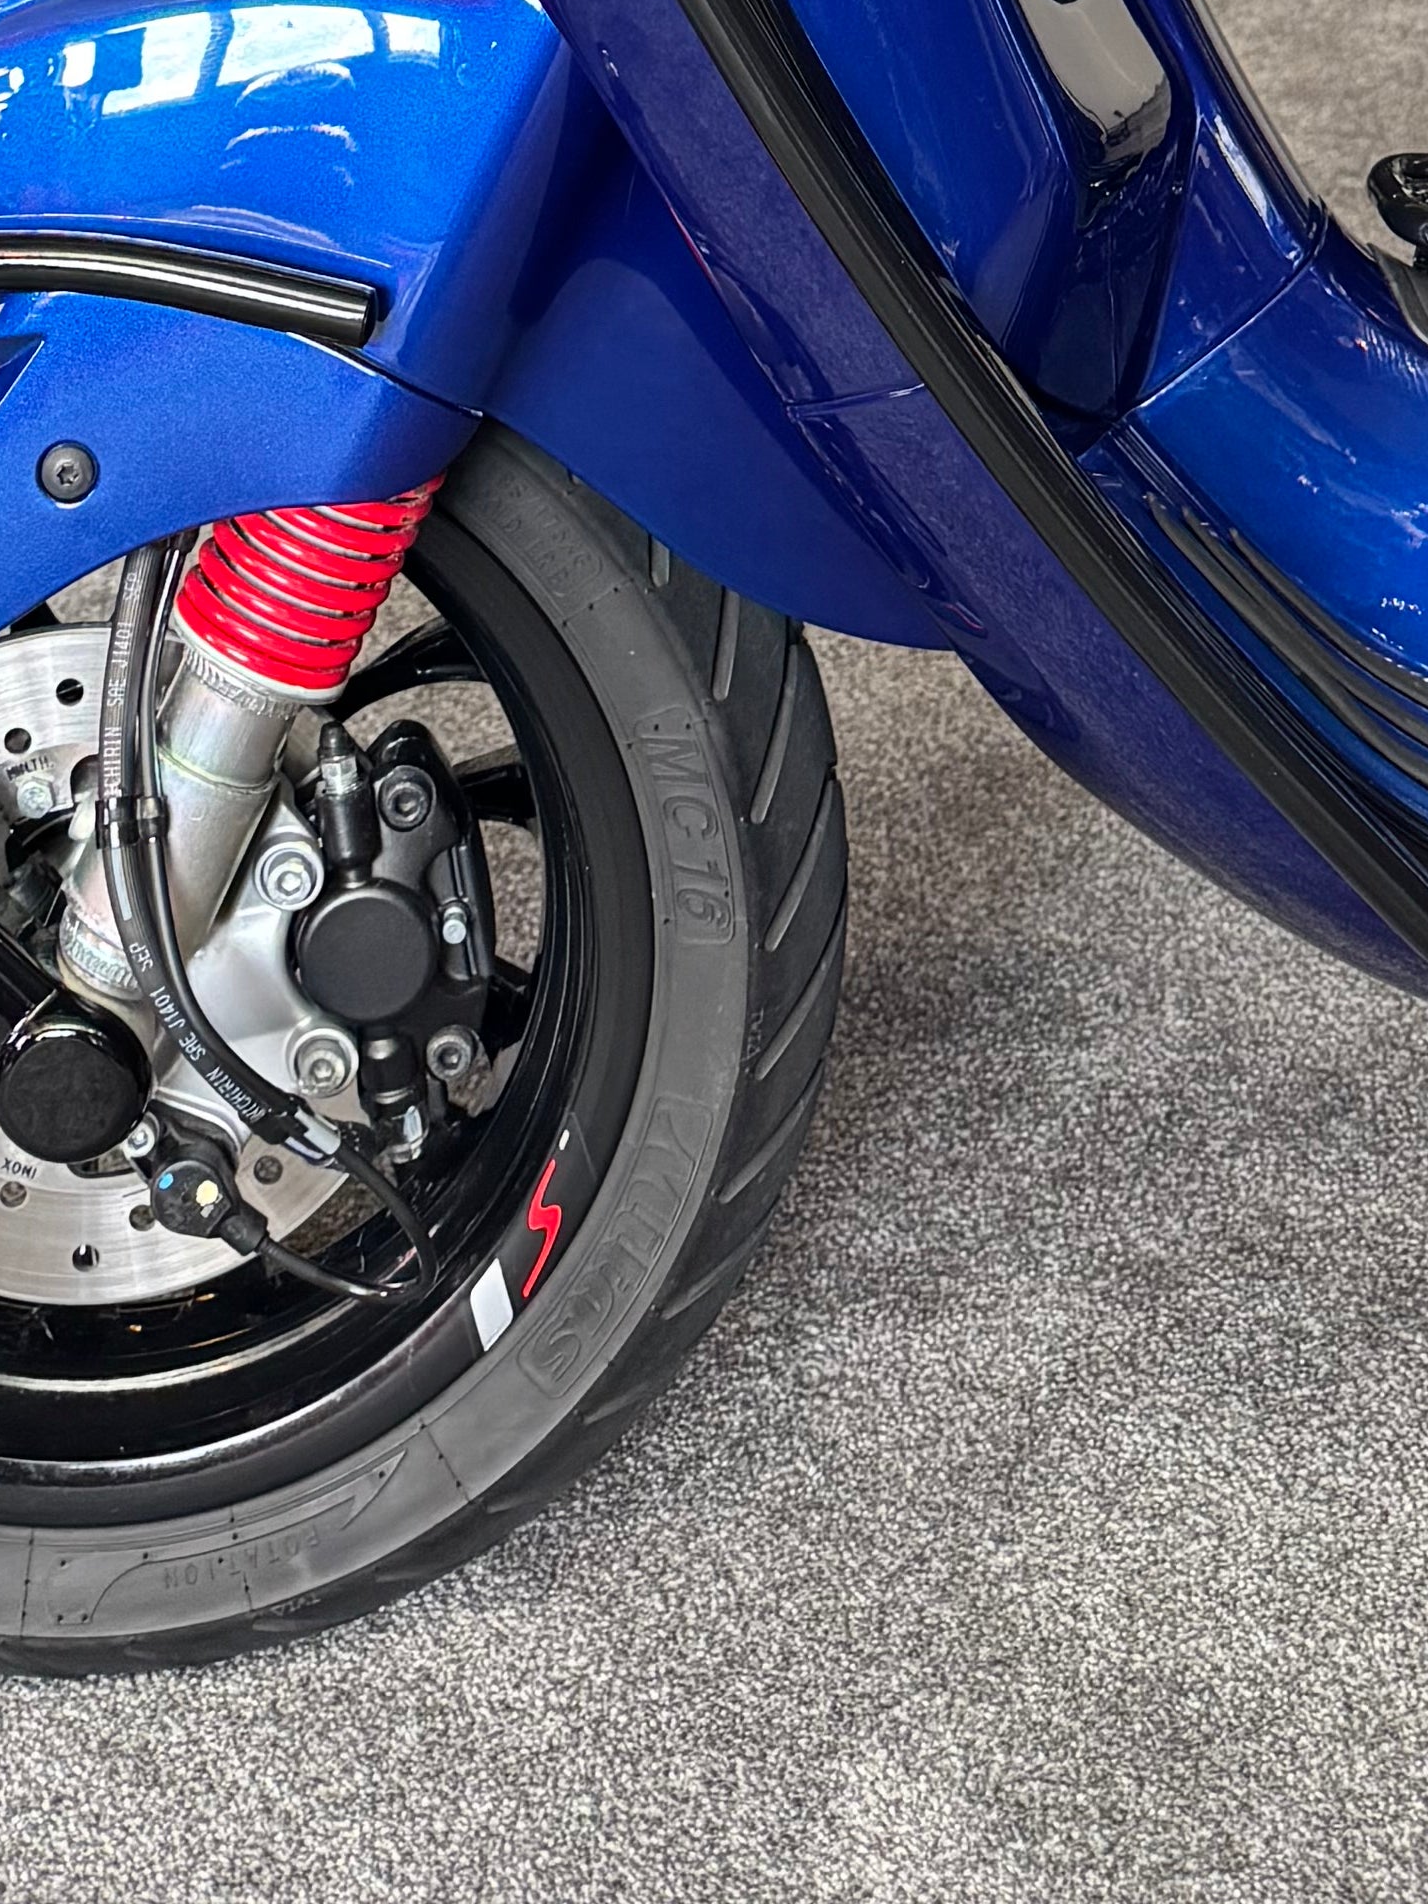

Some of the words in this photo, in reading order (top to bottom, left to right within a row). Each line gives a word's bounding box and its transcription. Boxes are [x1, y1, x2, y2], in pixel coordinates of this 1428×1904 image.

[111, 621, 133, 668] J1401
[107, 677, 126, 708] SAE
[128, 941, 155, 973] SEP
[149, 984, 188, 1033] J1401
[178, 1030, 208, 1063] SAE
[0, 1157, 37, 1181] INOX
[160, 1525, 323, 1593] ROTATION
